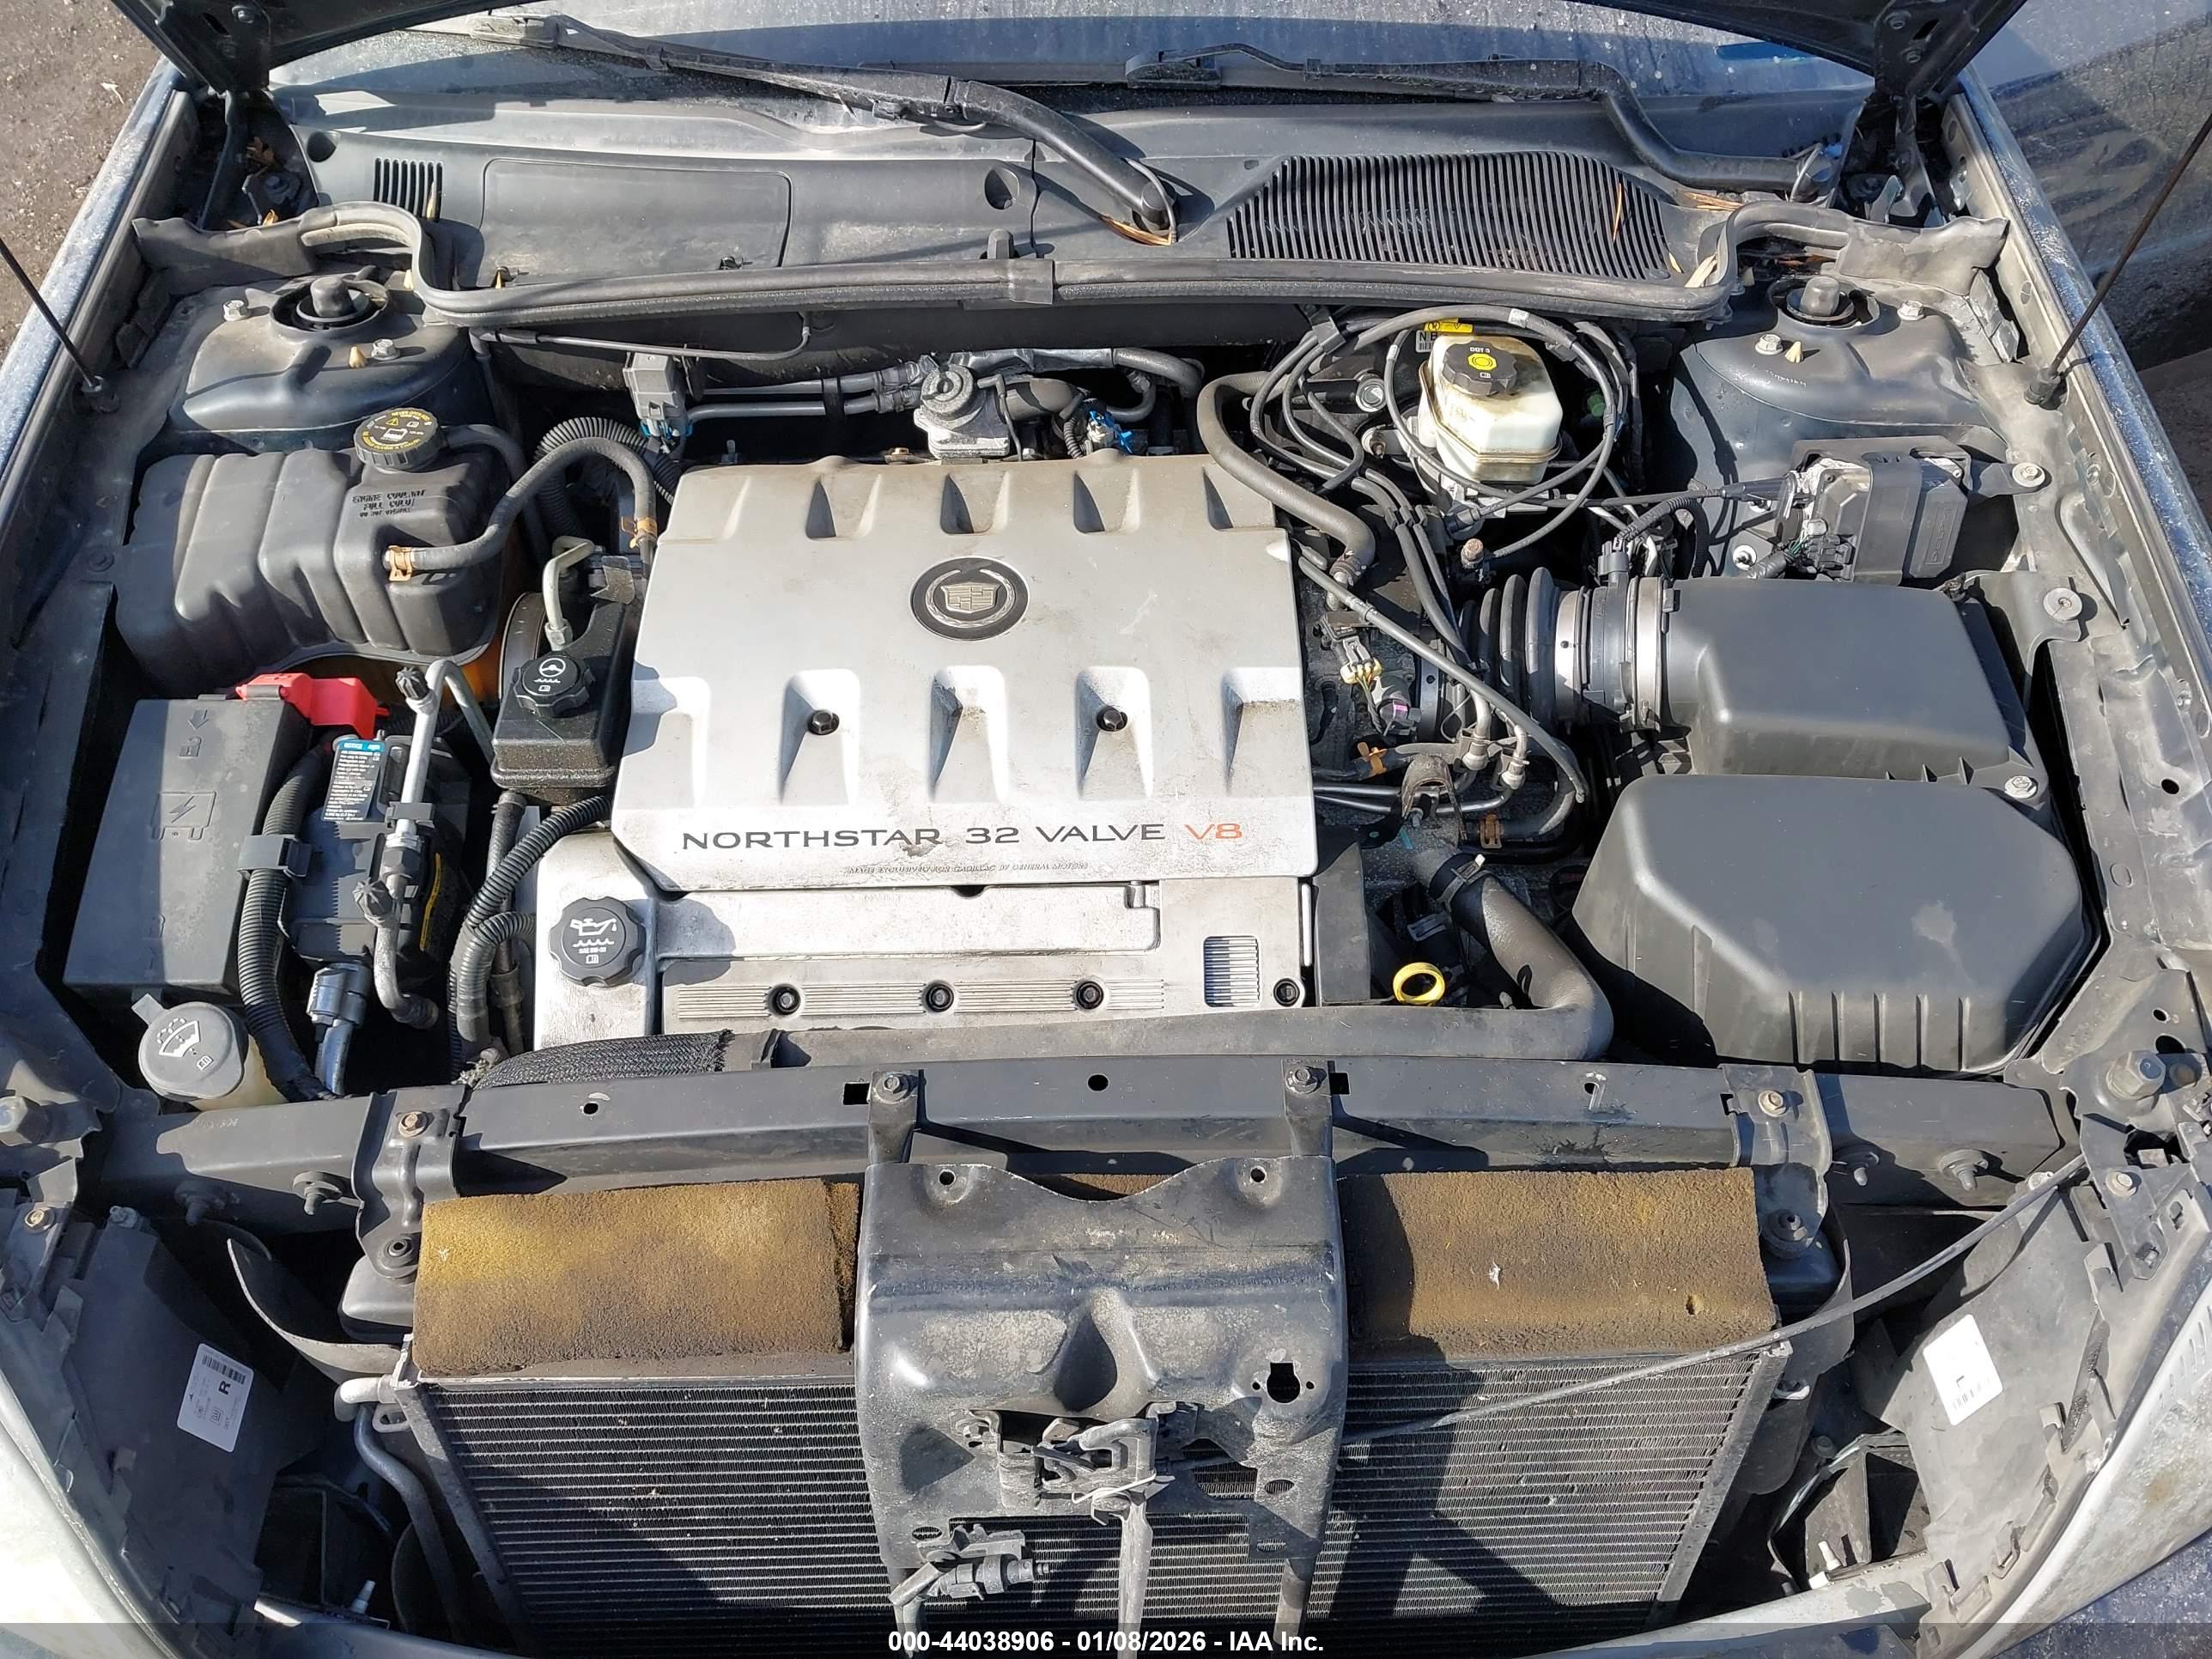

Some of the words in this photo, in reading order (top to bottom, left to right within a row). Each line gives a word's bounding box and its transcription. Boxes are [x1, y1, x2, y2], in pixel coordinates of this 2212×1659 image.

[683, 829, 944, 849] NORTHSTAR
[965, 827, 1020, 844] 32
[1036, 823, 1165, 842] VALVE
[1184, 823, 1243, 840] V8
[1012, 862, 1050, 872] GENERAL
[1052, 860, 1089, 871] MOTORS
[218, 1380, 232, 1395] R
